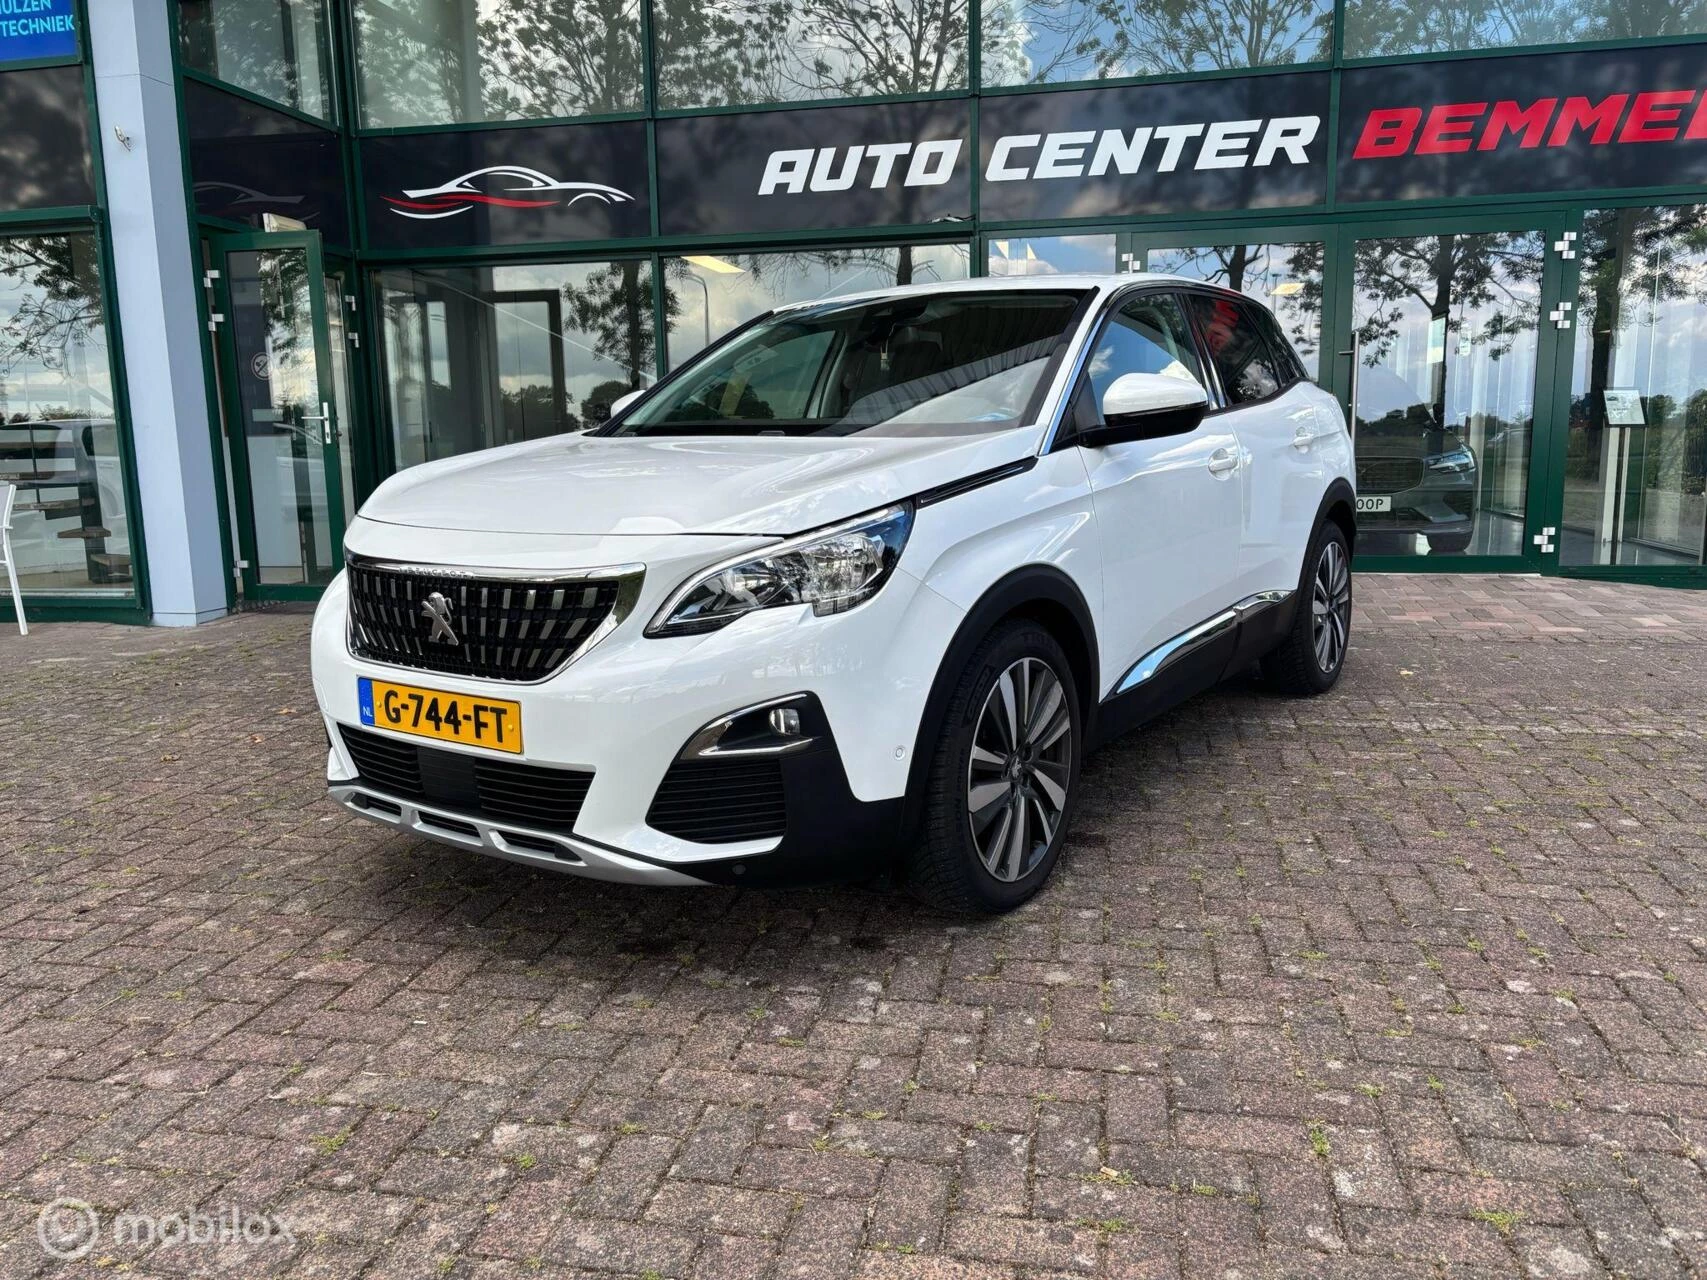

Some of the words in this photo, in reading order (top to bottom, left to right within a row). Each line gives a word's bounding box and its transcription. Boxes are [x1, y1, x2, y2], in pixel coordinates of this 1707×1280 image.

[0, 0, 52, 14] ULZEN
[0, 14, 75, 37] TECHNIEK
[758, 139, 963, 195] AUTO
[985, 115, 1321, 182] CENTER
[362, 706, 373, 718] NL
[384, 690, 507, 743] G-744-FT
